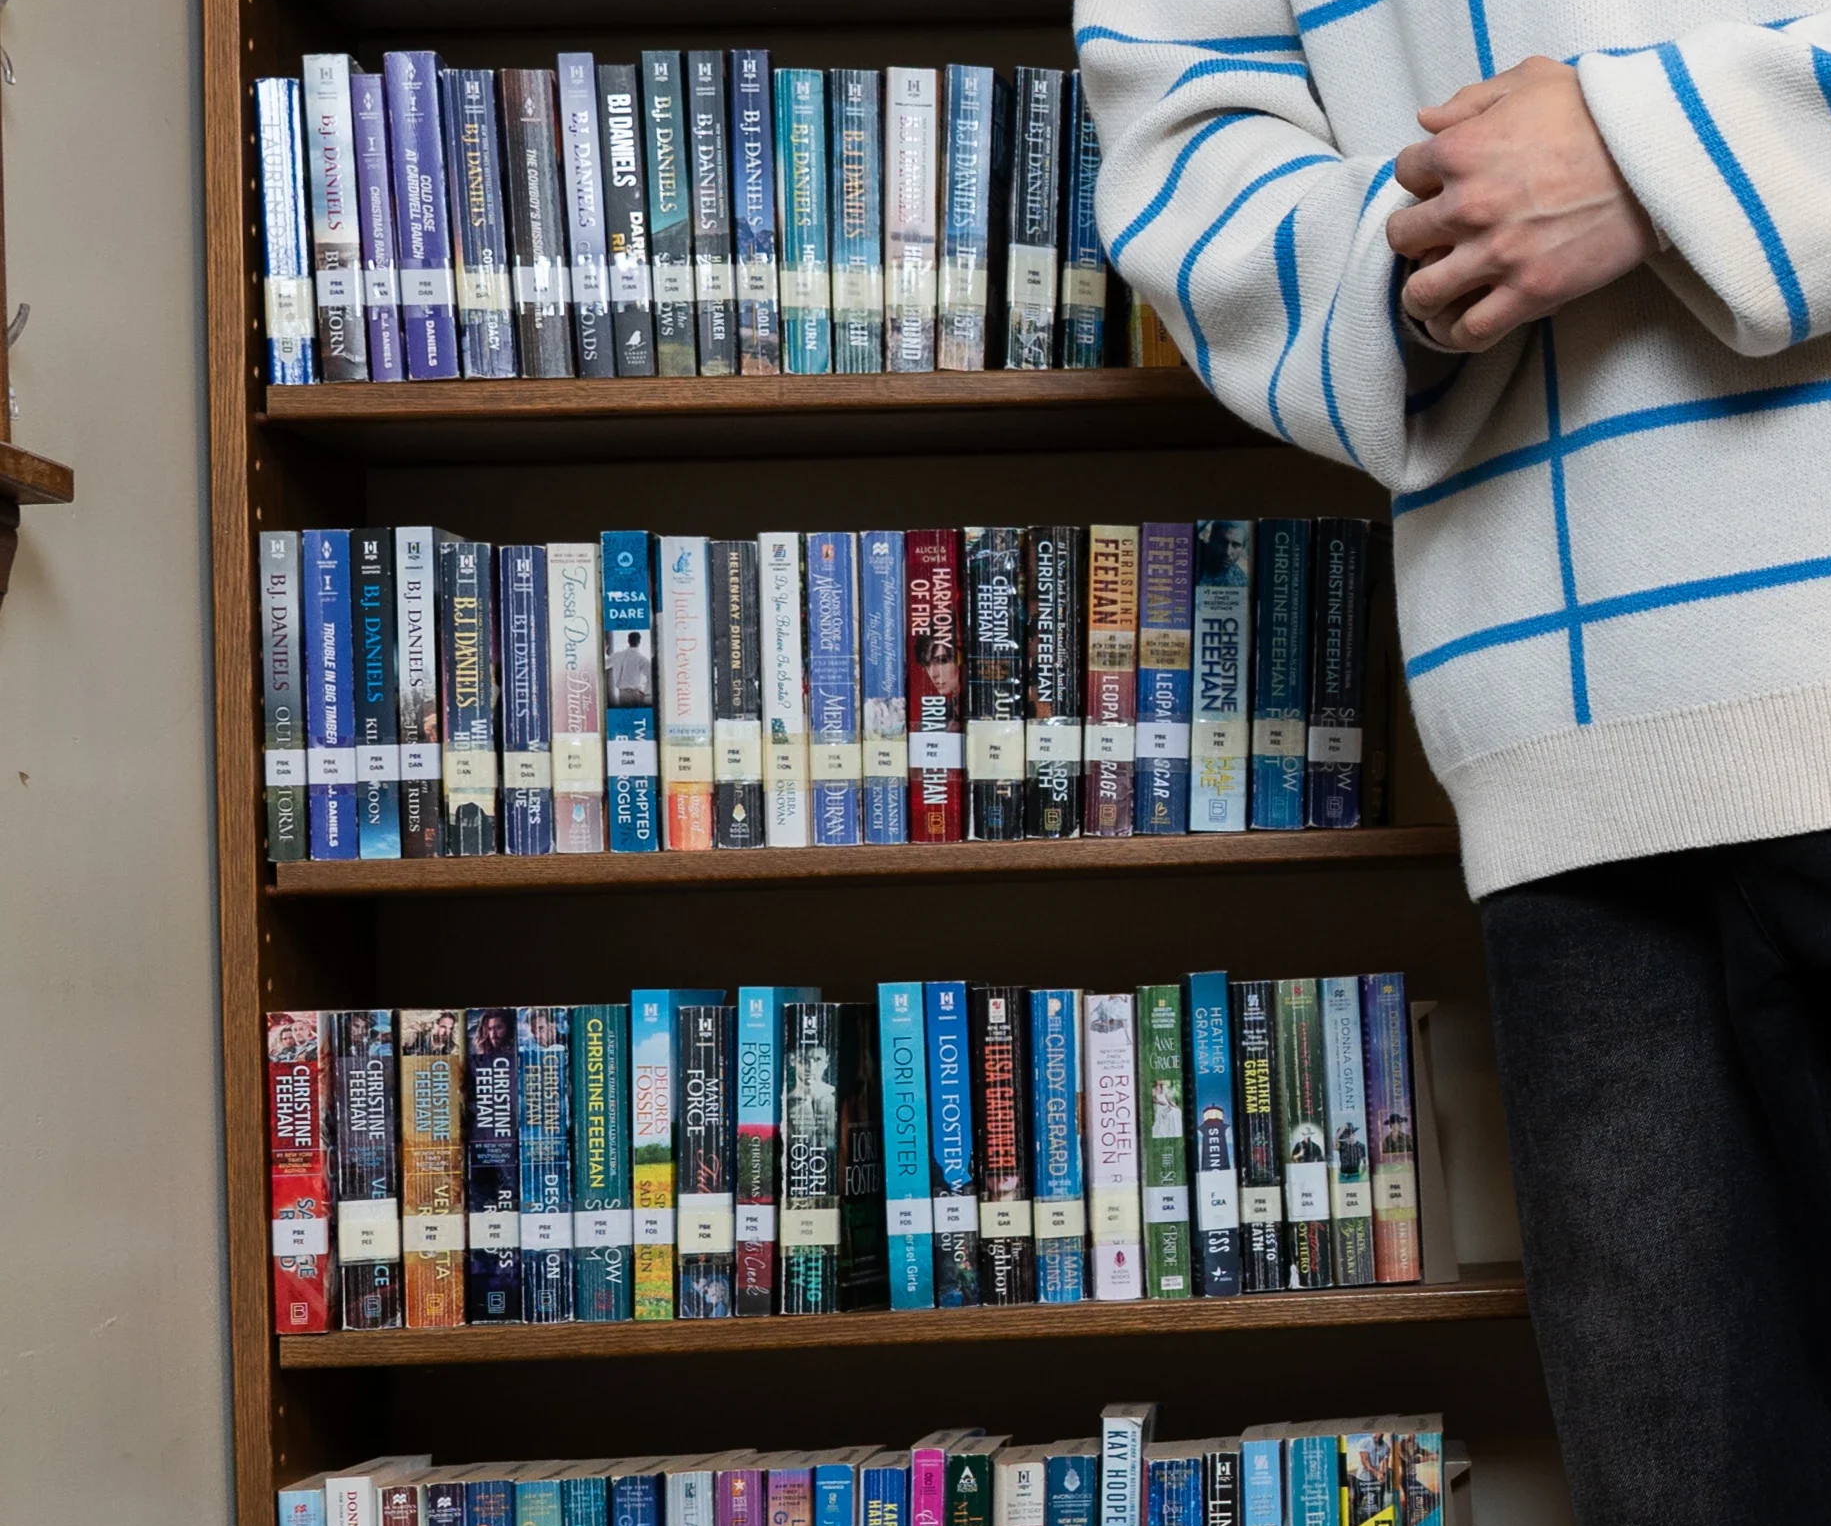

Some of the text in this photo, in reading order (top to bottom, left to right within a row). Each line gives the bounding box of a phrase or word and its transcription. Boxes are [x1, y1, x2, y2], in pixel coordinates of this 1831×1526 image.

[607, 94, 636, 187] BJ DANIELS
[421, 175, 434, 232] COLD CASE
[562, 567, 589, 671] Tessa Dare
[912, 579, 929, 636] OF FIRE
[932, 568, 952, 648] HARMONY
[1038, 541, 1053, 701] CHRISTINE FEEHAN
[324, 622, 337, 744] TROUBLE IN BIG TIMBER
[277, 1075, 293, 1137] FEEHAN
[293, 1066, 311, 1146] CHRISTINE
[587, 1019, 604, 1187] CHRISTINE FEEHAN
[637, 1065, 654, 1135] FOSSEN
[654, 1066, 668, 1134] DELORES
[939, 1035, 963, 1173] LORI FOSTER
[1101, 1075, 1116, 1164] GIBSON
[1116, 1075, 1131, 1163] RACHEL
[1245, 1060, 1259, 1113] GRAHAM
[1257, 1059, 1270, 1113] HEATHER
[1107, 1430, 1127, 1463] KAY
